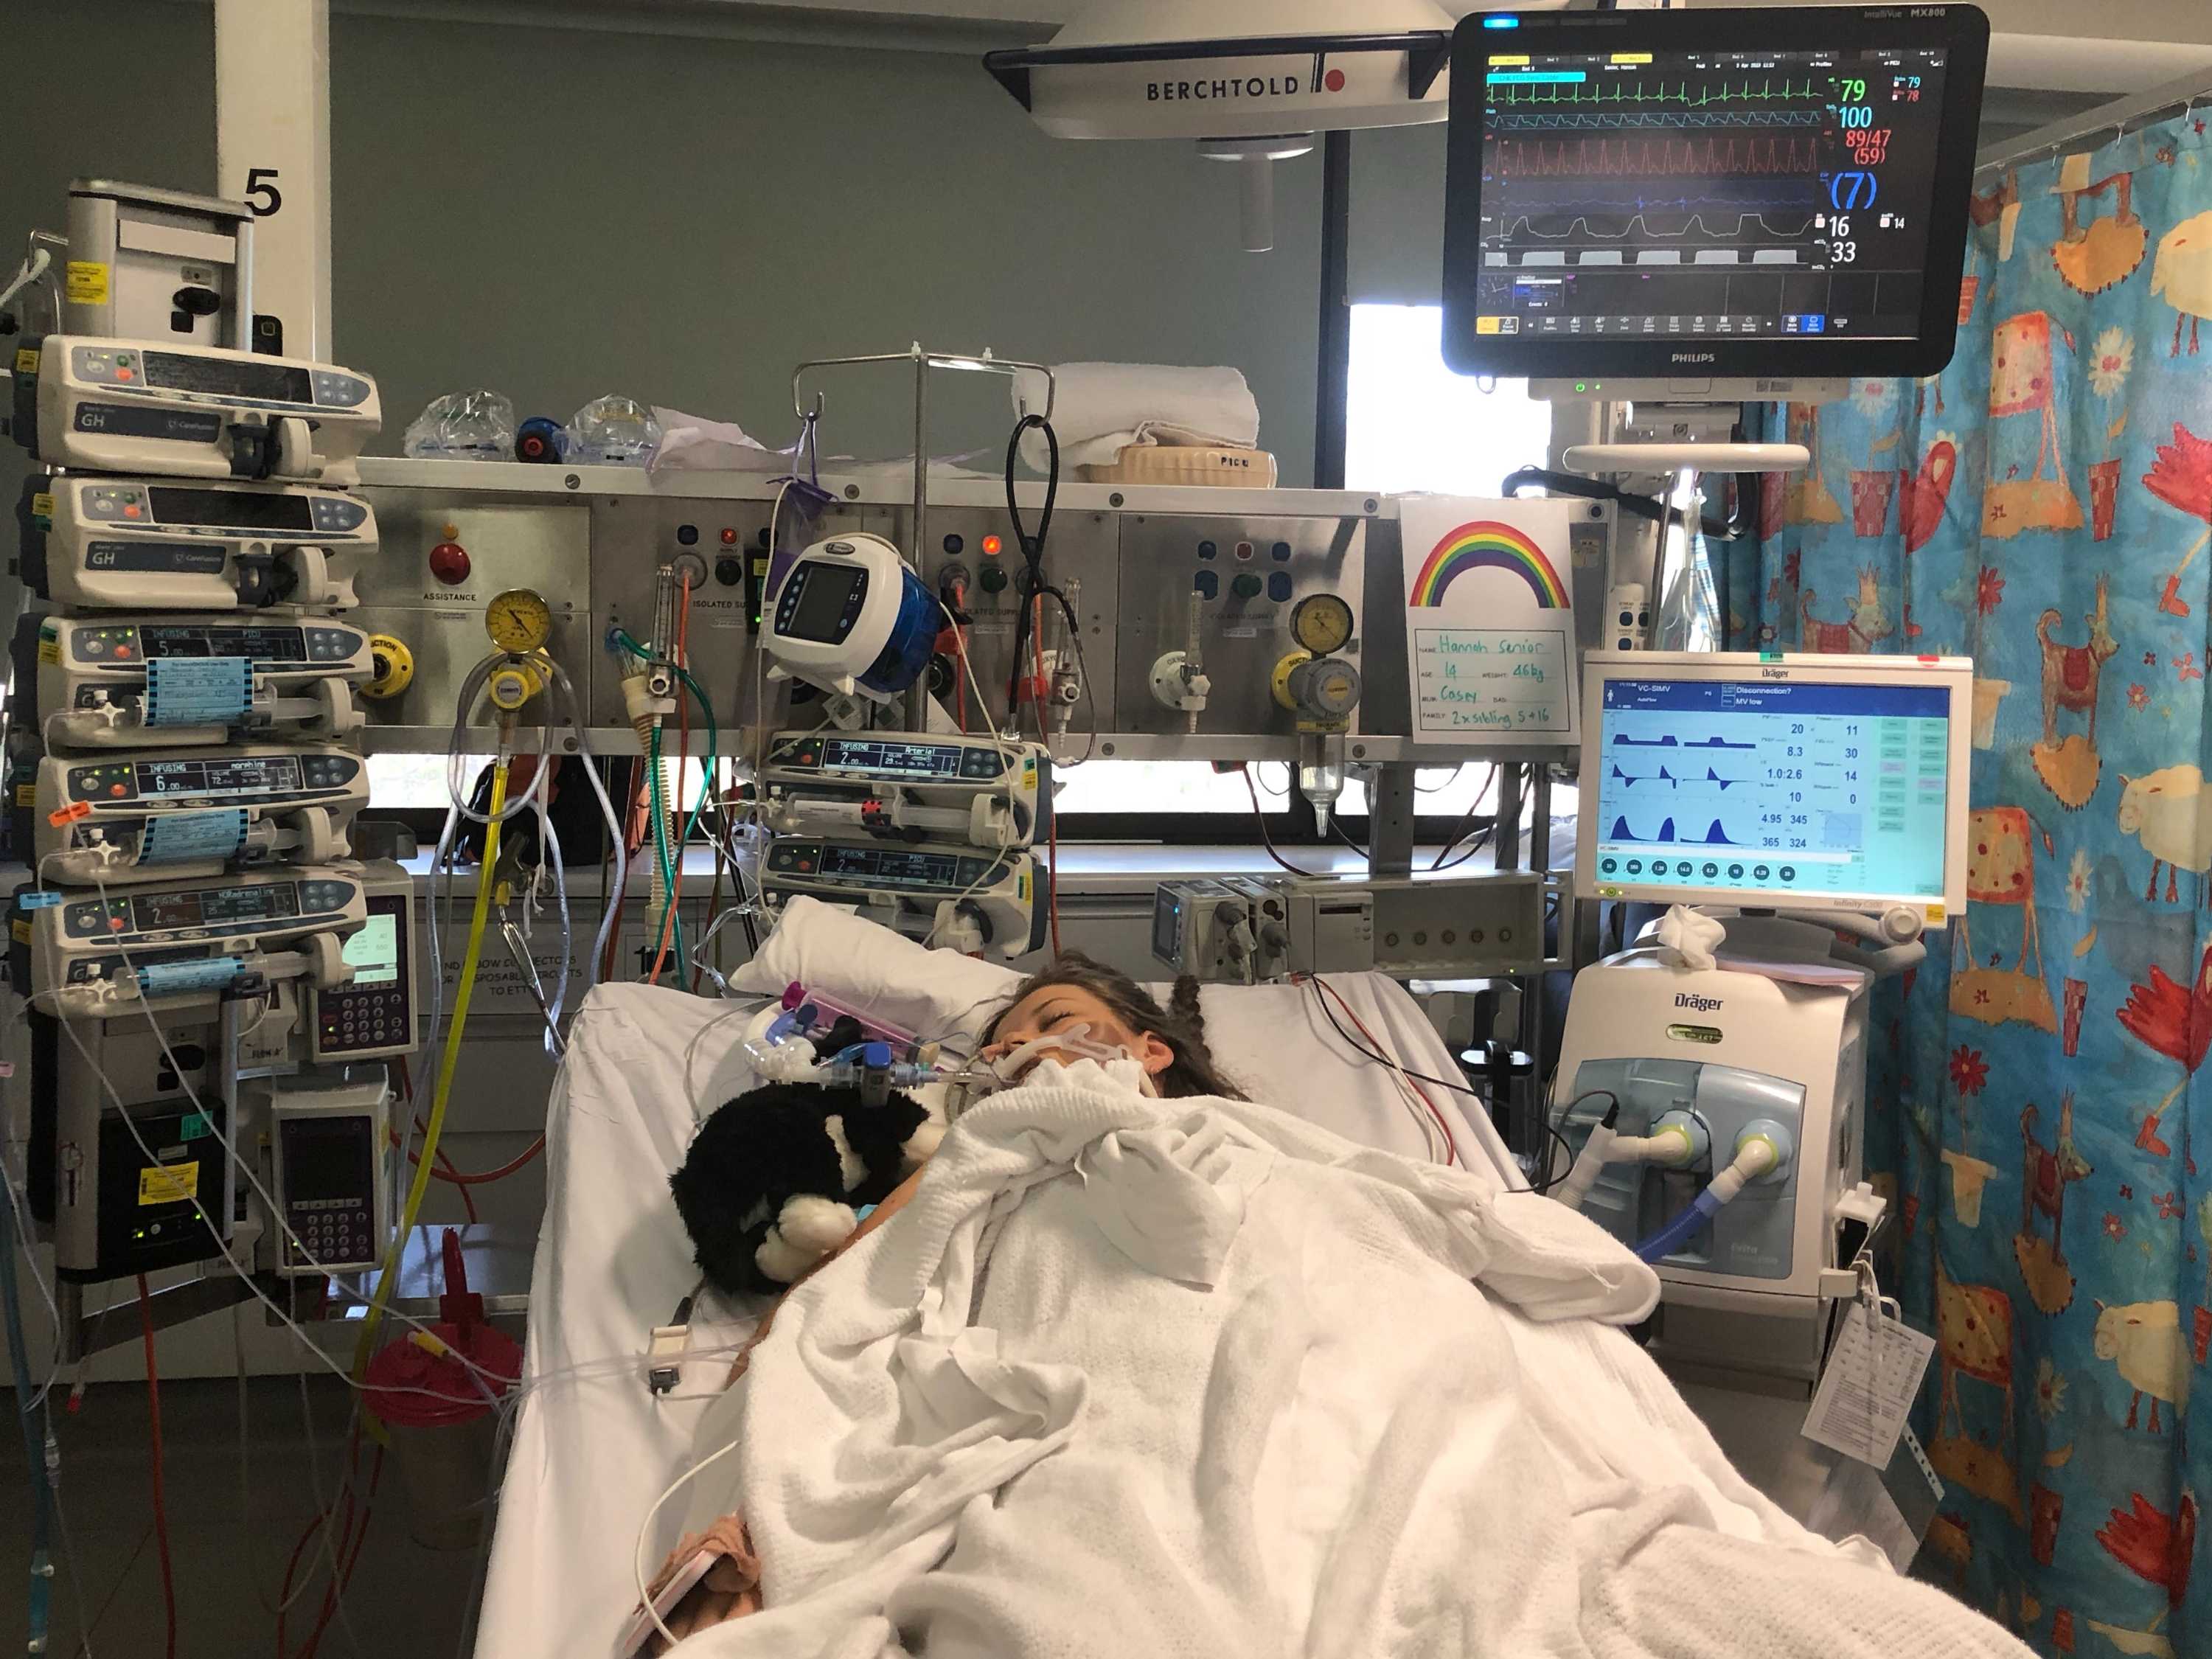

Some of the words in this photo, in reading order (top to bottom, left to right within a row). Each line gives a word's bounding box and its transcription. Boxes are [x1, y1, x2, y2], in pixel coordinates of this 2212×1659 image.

[1910, 8, 1946, 18] MX800
[1147, 76, 1298, 100] BERCHTOLD
[1908, 77, 1921, 88] 79
[1841, 80, 1865, 102] 79
[1907, 90, 1919, 102] 78
[1839, 107, 1872, 128] 100
[1846, 130, 1892, 147] 89/47
[1854, 148, 1885, 164] (59)
[243, 169, 282, 216] 5
[1831, 172, 1877, 210] (7)
[1829, 216, 1850, 237] 16
[1894, 218, 1905, 229] 14
[1831, 242, 1857, 262] 33
[1672, 353, 1715, 363] PHILIPS
[81, 414, 105, 428] GH
[92, 552, 115, 565] GH
[423, 593, 477, 602] ASSISTANCE
[1445, 661, 1456, 681] 14
[1762, 668, 1789, 679] Dräger
[1736, 686, 1792, 695] Disconnection?
[1791, 723, 1804, 734] 20
[1846, 725, 1858, 736] 11
[840, 742, 869, 751] INFUSING
[905, 746, 936, 755] Arterial
[1787, 746, 1804, 757] 8.3
[1845, 748, 1858, 759] 30
[150, 763, 187, 773] INFUSING
[231, 761, 266, 769] morphine
[1845, 771, 1857, 782] 14
[1790, 791, 1802, 802] 10
[1849, 793, 1857, 804] 0
[1761, 813, 1782, 824] 4.95
[1790, 815, 1808, 825] 345
[1762, 837, 1780, 847] 365
[1790, 838, 1806, 848] 324
[1834, 900, 1863, 908] Infinity
[489, 986, 504, 995] TO
[1674, 992, 1724, 1012] Dräger
